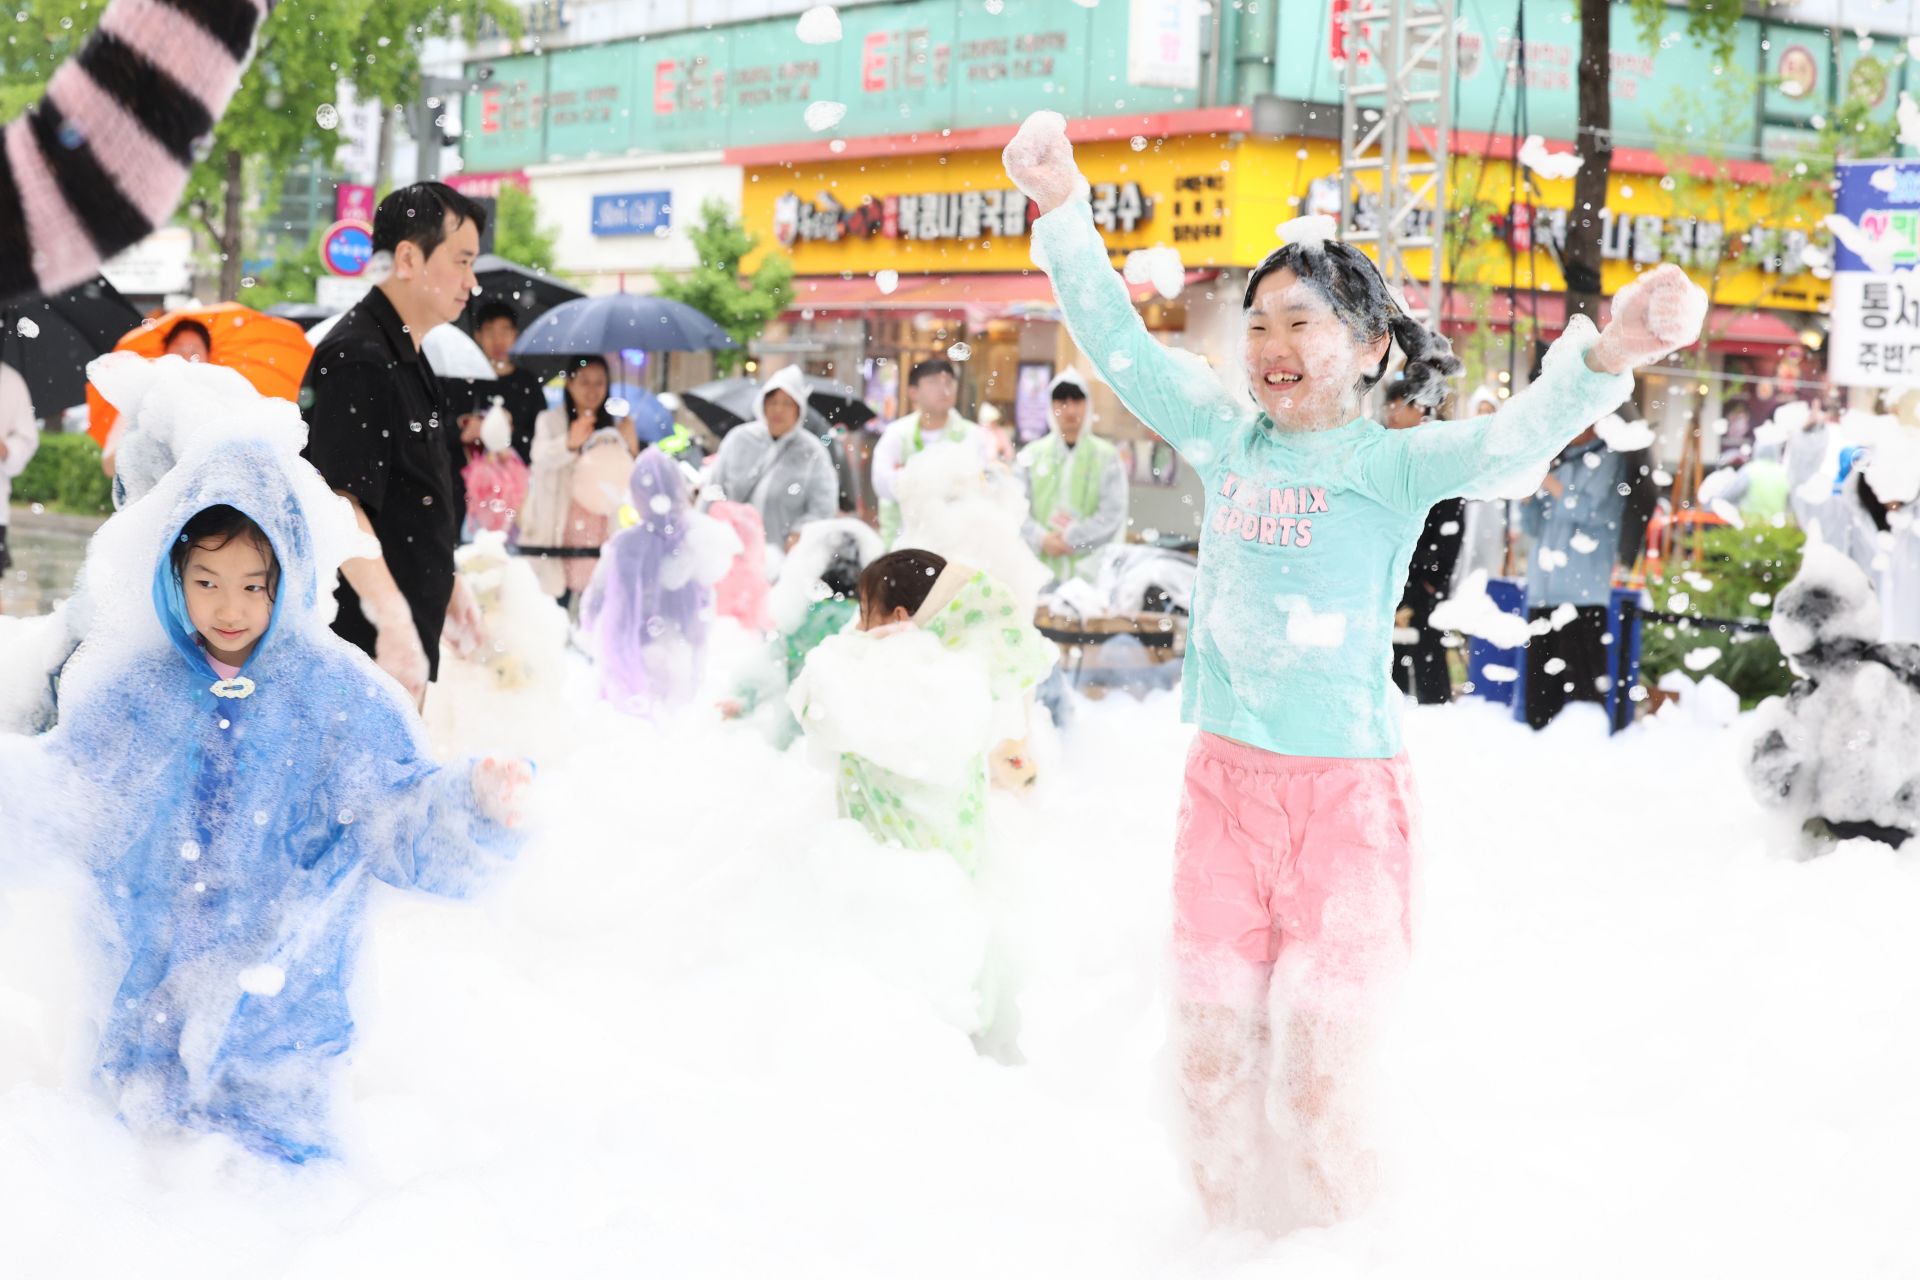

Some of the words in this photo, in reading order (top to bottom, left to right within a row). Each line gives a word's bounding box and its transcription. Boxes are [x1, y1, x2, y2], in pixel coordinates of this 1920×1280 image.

[1859, 343, 1920, 373] 주변
[1269, 486, 1329, 515] MIX
[1211, 504, 1313, 548] SPORTS
